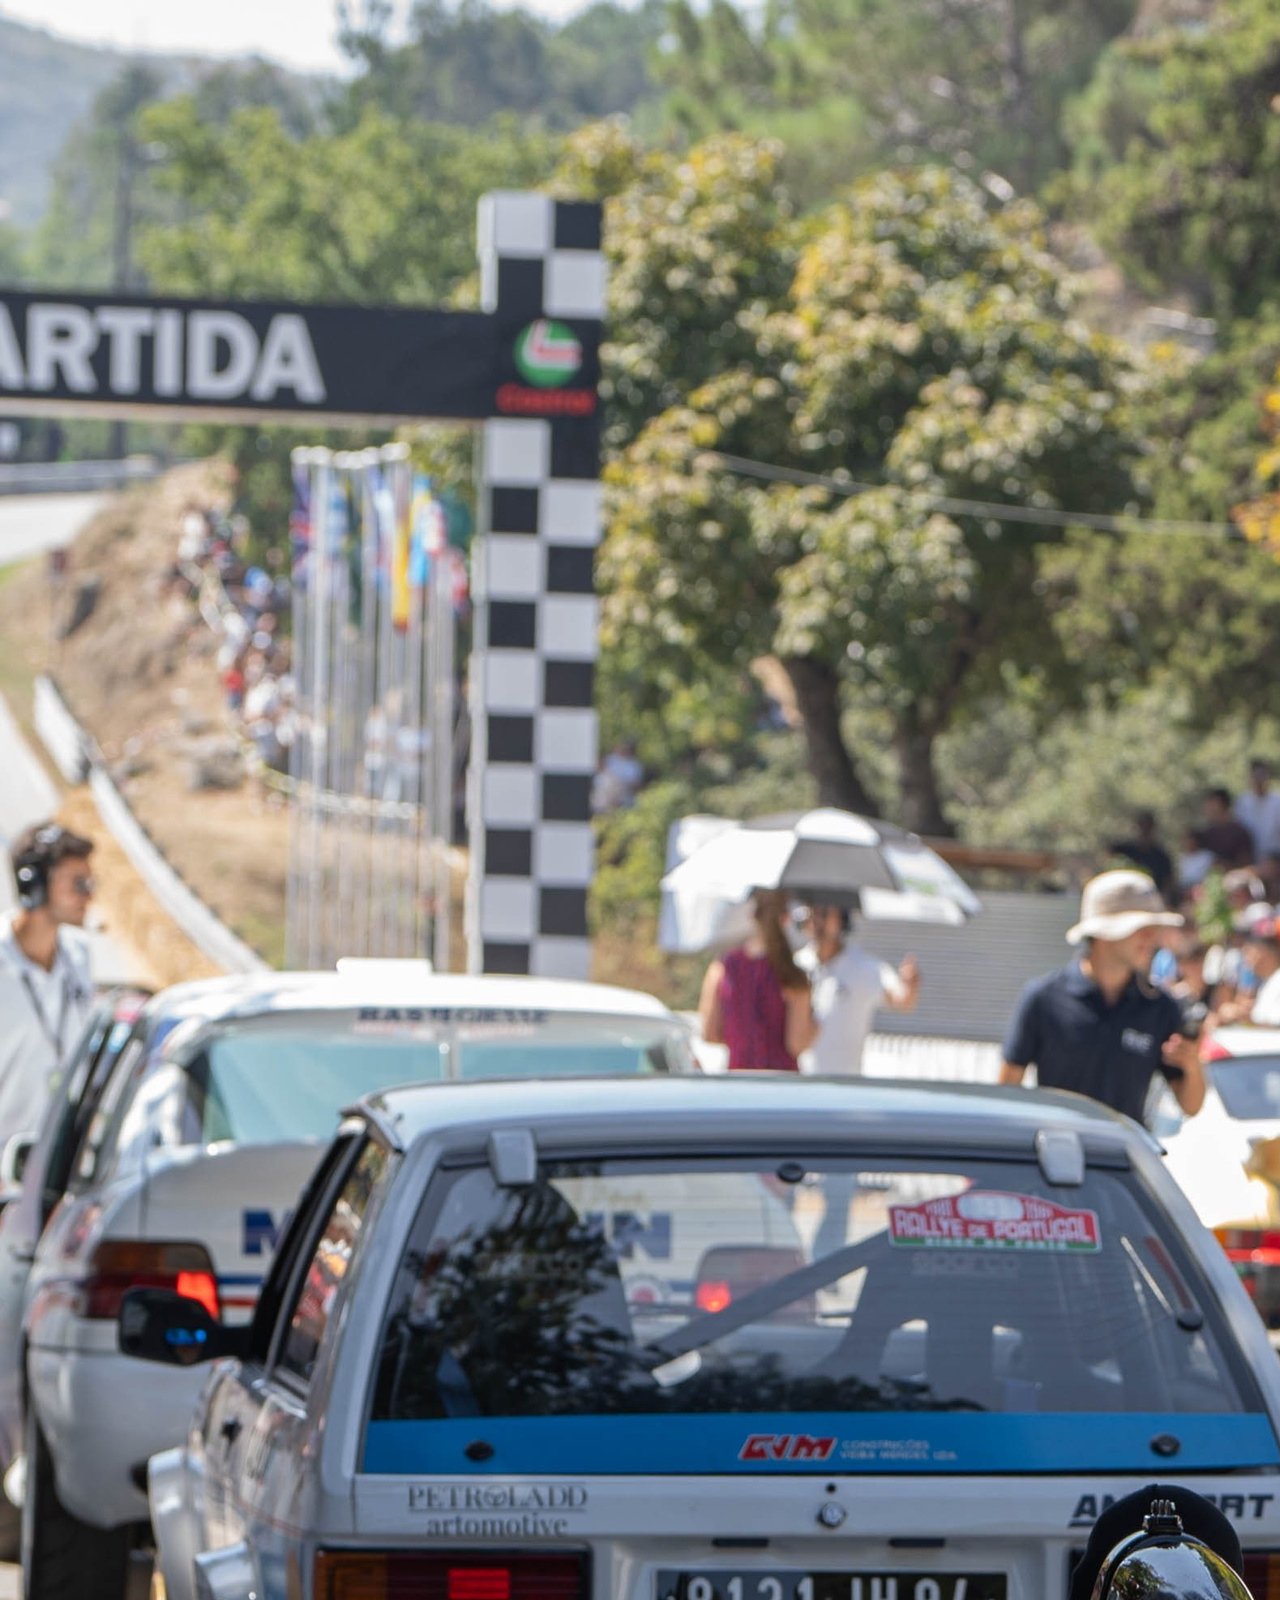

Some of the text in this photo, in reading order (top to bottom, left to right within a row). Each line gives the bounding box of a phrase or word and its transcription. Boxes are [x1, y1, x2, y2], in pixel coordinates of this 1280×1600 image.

[894, 1209, 963, 1237] RALLYE
[993, 1216, 1092, 1241] PORTUGAL
[427, 1512, 568, 1537] artomotive
